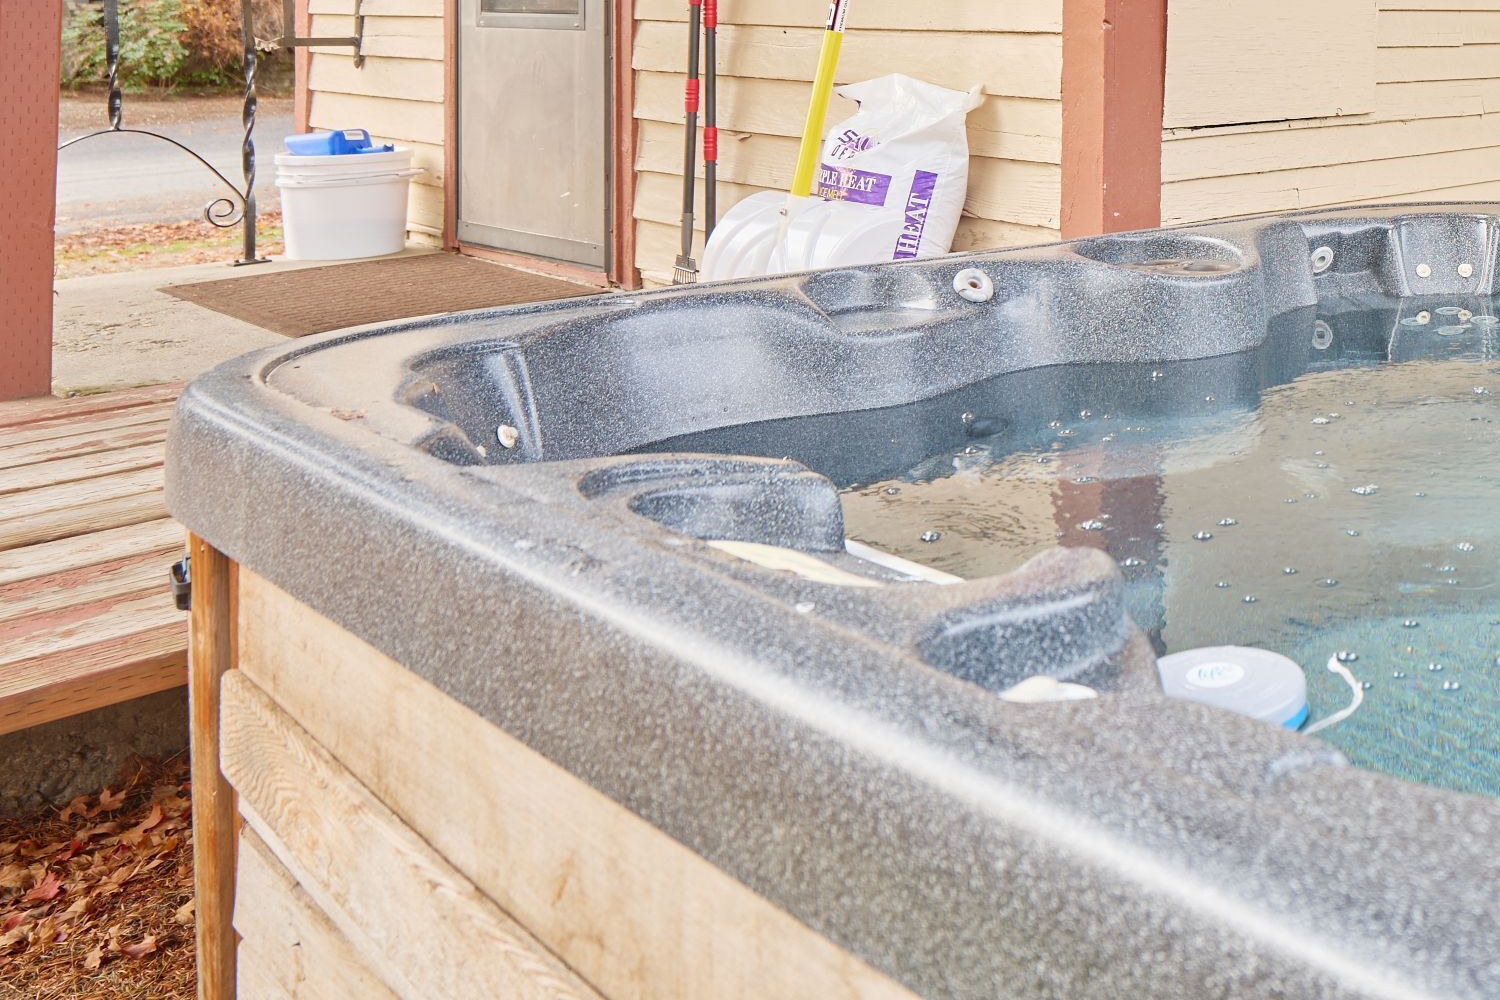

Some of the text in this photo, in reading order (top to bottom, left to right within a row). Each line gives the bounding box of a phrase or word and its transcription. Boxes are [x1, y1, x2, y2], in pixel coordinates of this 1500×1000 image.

[820, 169, 877, 192] PLE HEAT
[895, 192, 929, 255] HEAT
